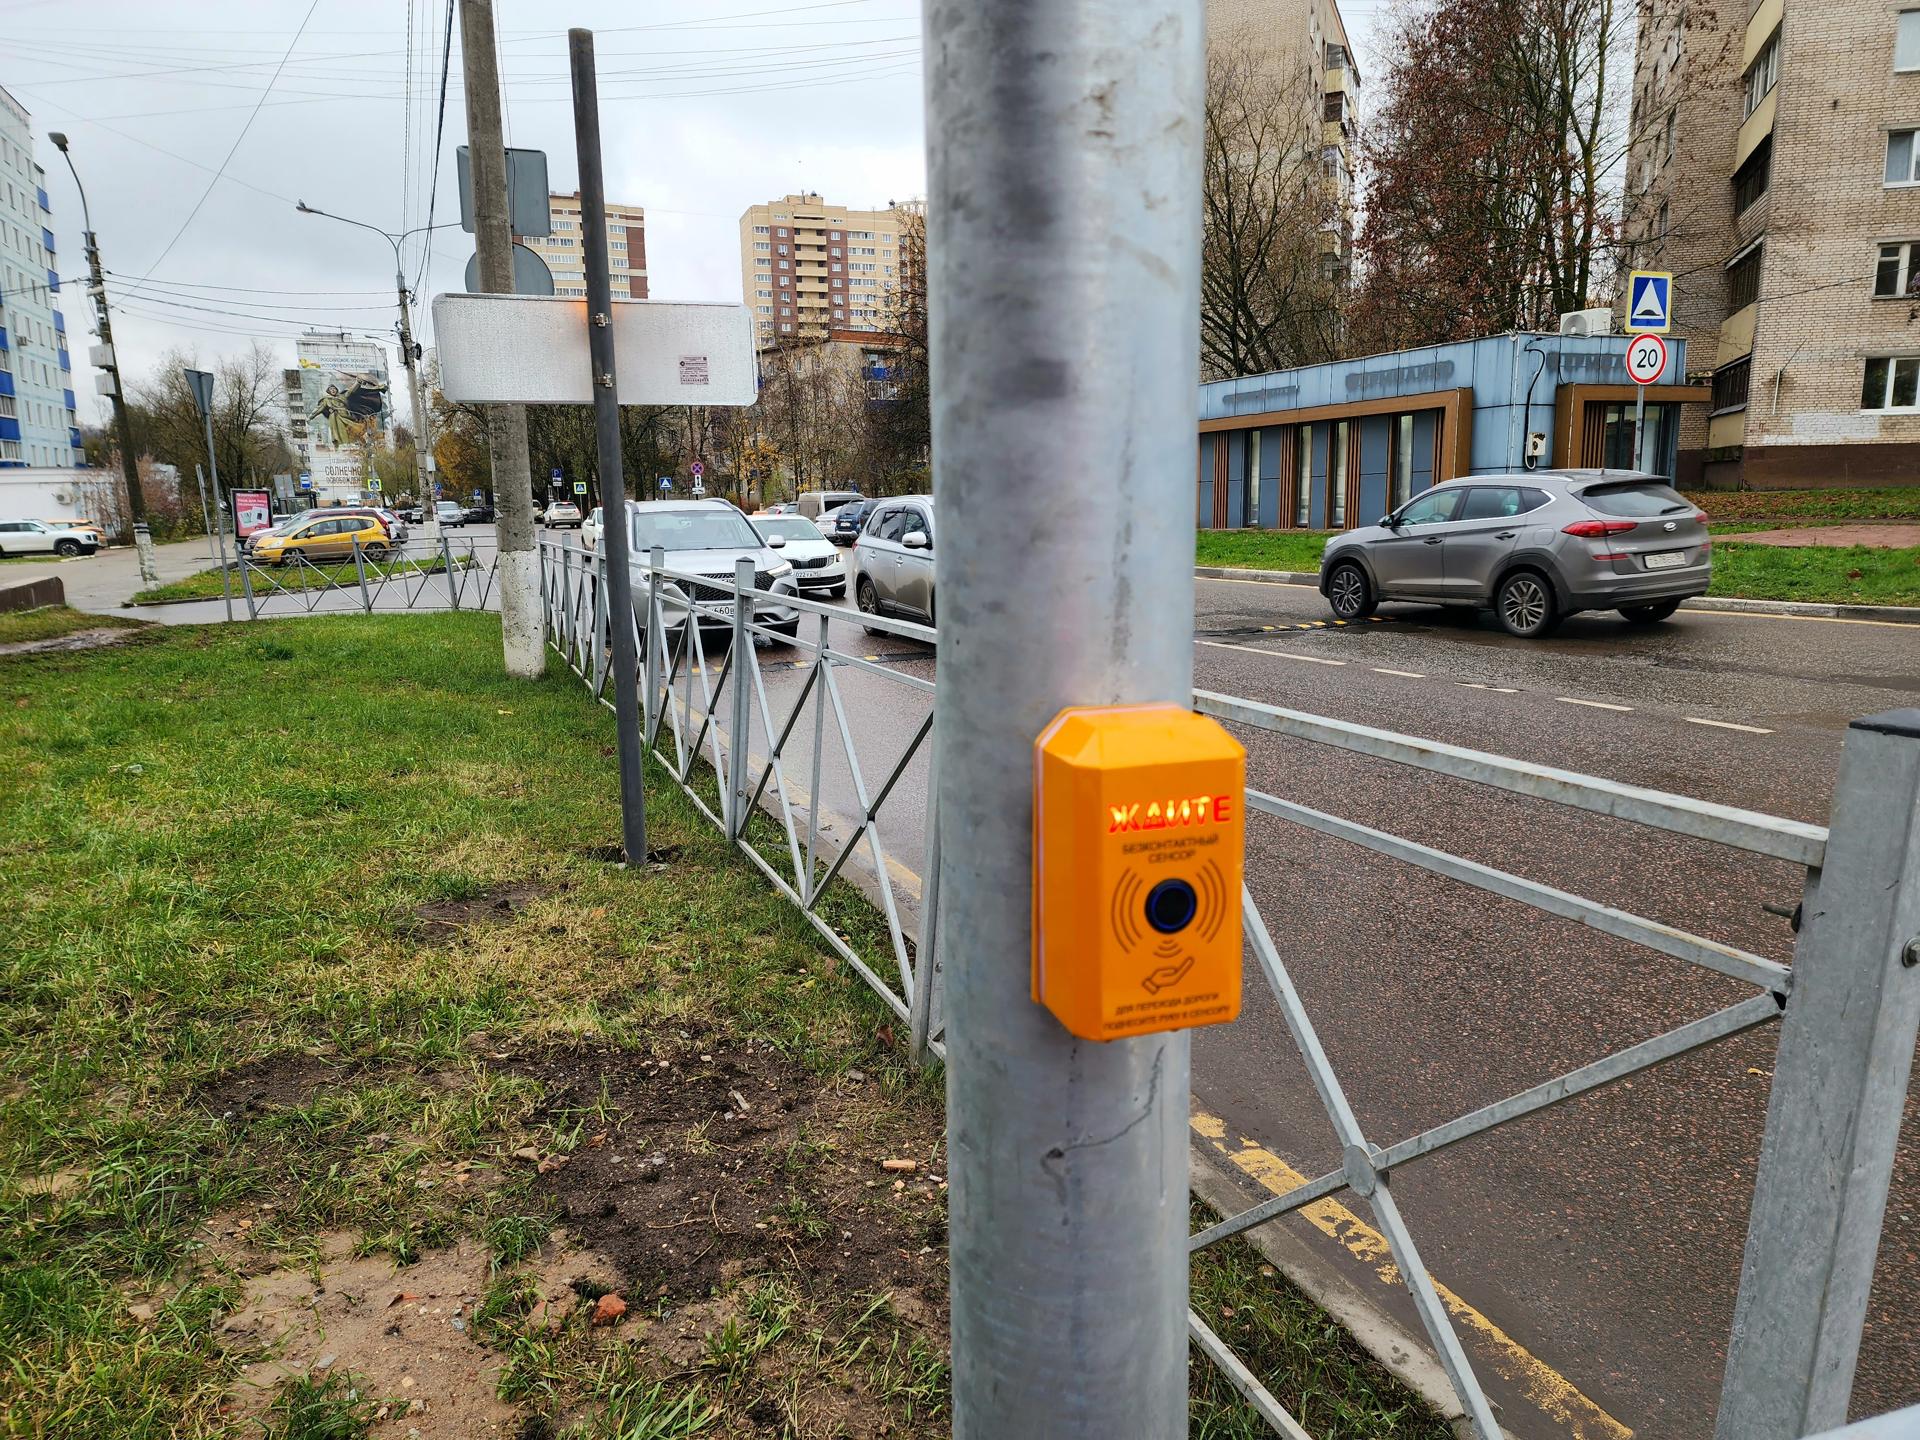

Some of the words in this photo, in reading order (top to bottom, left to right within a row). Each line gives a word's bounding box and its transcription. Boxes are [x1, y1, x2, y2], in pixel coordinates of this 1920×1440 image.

[1636, 348, 1658, 368] 20
[325, 465, 362, 476] СОЛНЕЧНО
[1108, 796, 1231, 833] ЖДИТЕ
[1148, 849, 1196, 864] СЕНСОР
[1115, 1004, 1134, 1016] ДЛЯ
[1136, 998, 1182, 1012] ПЕРЕХОДА
[1183, 993, 1219, 1005] ДОРОГИ
[1159, 1012, 1180, 1023] РУКУ
[1182, 1010, 1188, 1019] К
[1189, 1005, 1231, 1019] СЕНСОРУ
